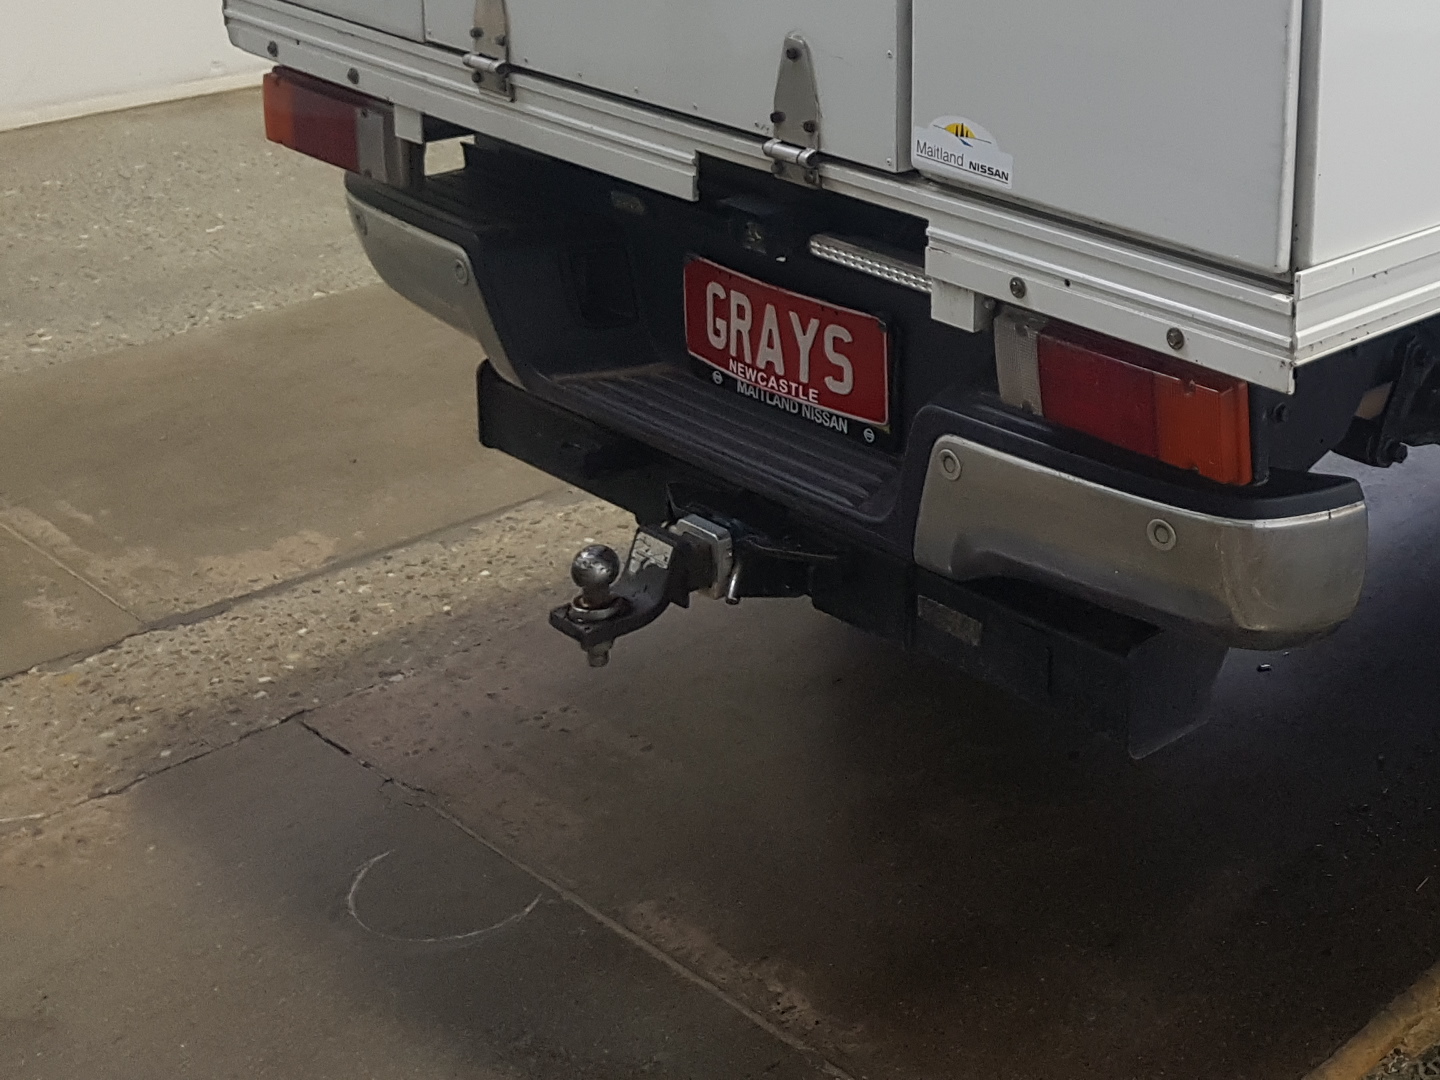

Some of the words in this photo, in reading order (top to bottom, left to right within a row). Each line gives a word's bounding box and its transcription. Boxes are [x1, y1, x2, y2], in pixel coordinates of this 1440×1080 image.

[916, 139, 964, 167] Maitland
[968, 160, 1009, 182] NISSAN
[706, 281, 854, 395] GRAYS
[729, 358, 819, 404] NEWCASTLE
[801, 404, 848, 435] NISSAN
